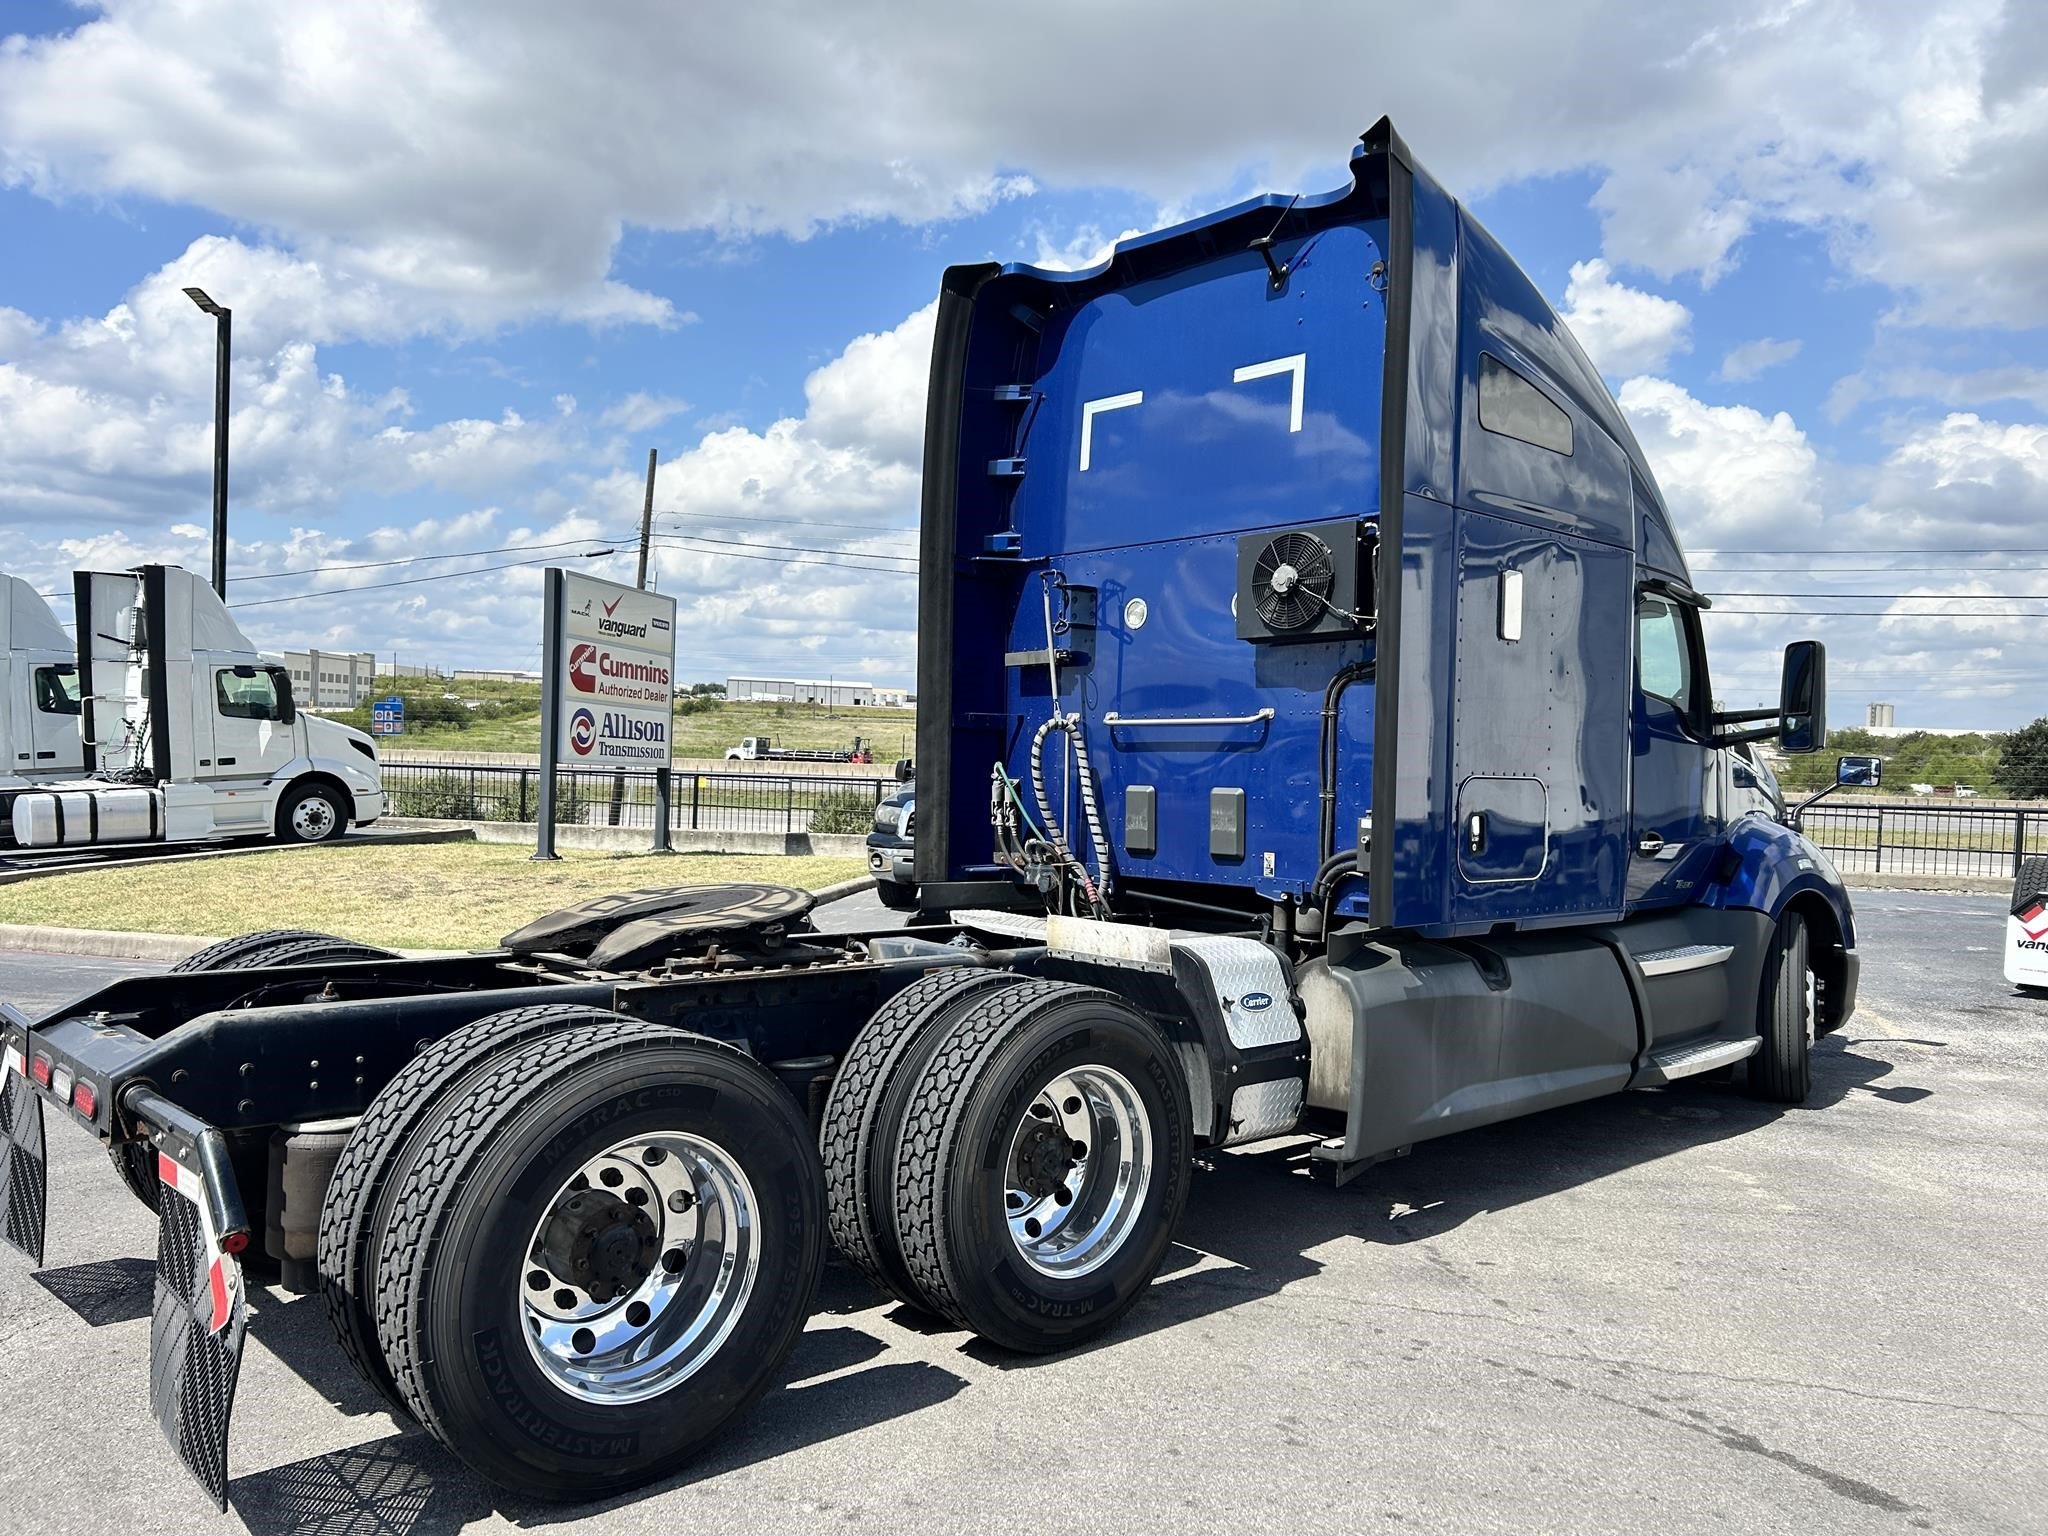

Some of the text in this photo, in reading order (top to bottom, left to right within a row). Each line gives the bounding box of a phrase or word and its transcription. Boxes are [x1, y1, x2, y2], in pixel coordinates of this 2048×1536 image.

[571, 609, 591, 617] MACK
[598, 617, 647, 638] vanguard
[569, 645, 595, 673] Cummins
[599, 652, 669, 685] Cummins
[598, 681, 668, 702] Authorized Dealer
[599, 712, 665, 742] Allison
[599, 741, 665, 759] Transmission
[1243, 996, 1269, 1007] Carrier
[1150, 1061, 1181, 1214] MASTERTRACK
[1026, 1294, 1095, 1317] M-TRAC
